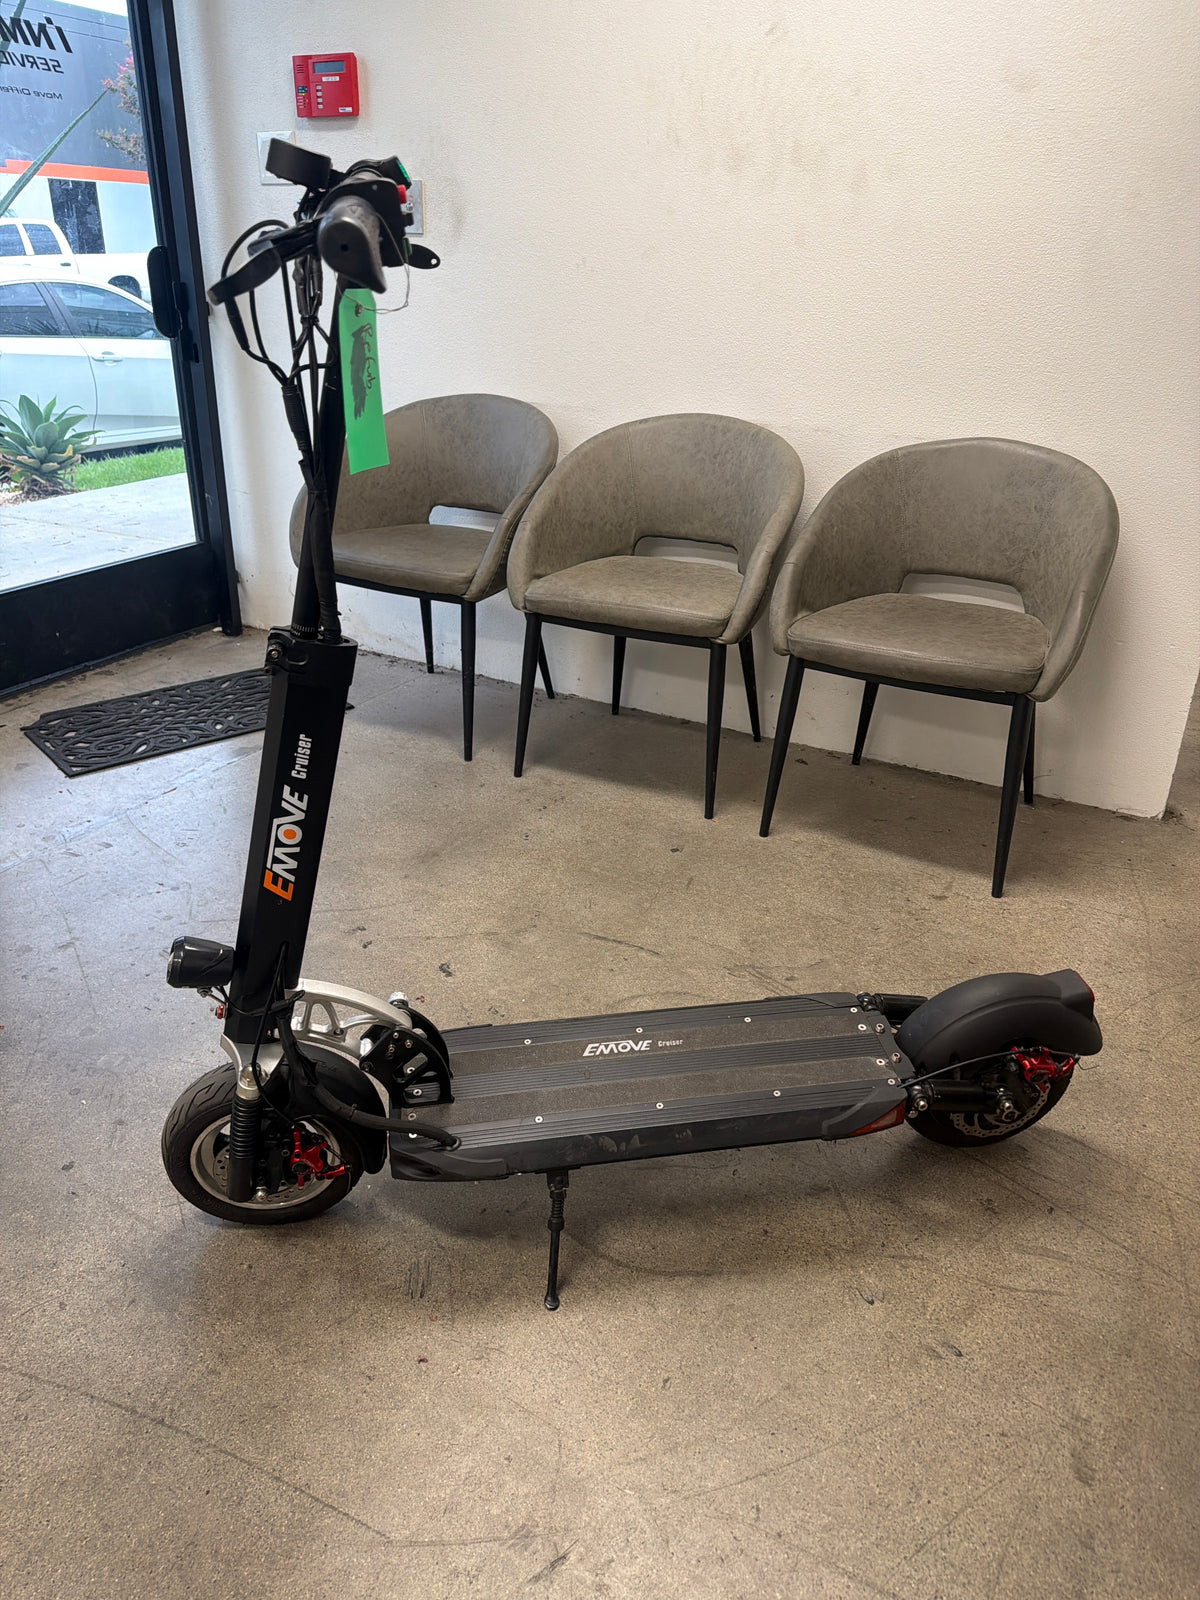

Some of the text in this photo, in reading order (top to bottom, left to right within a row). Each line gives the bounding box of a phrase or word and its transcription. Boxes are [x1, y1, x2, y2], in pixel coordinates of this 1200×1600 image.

[263, 733, 313, 901] EMOVE Cruiser
[582, 1039, 684, 1057] EMOVE Cruiser
